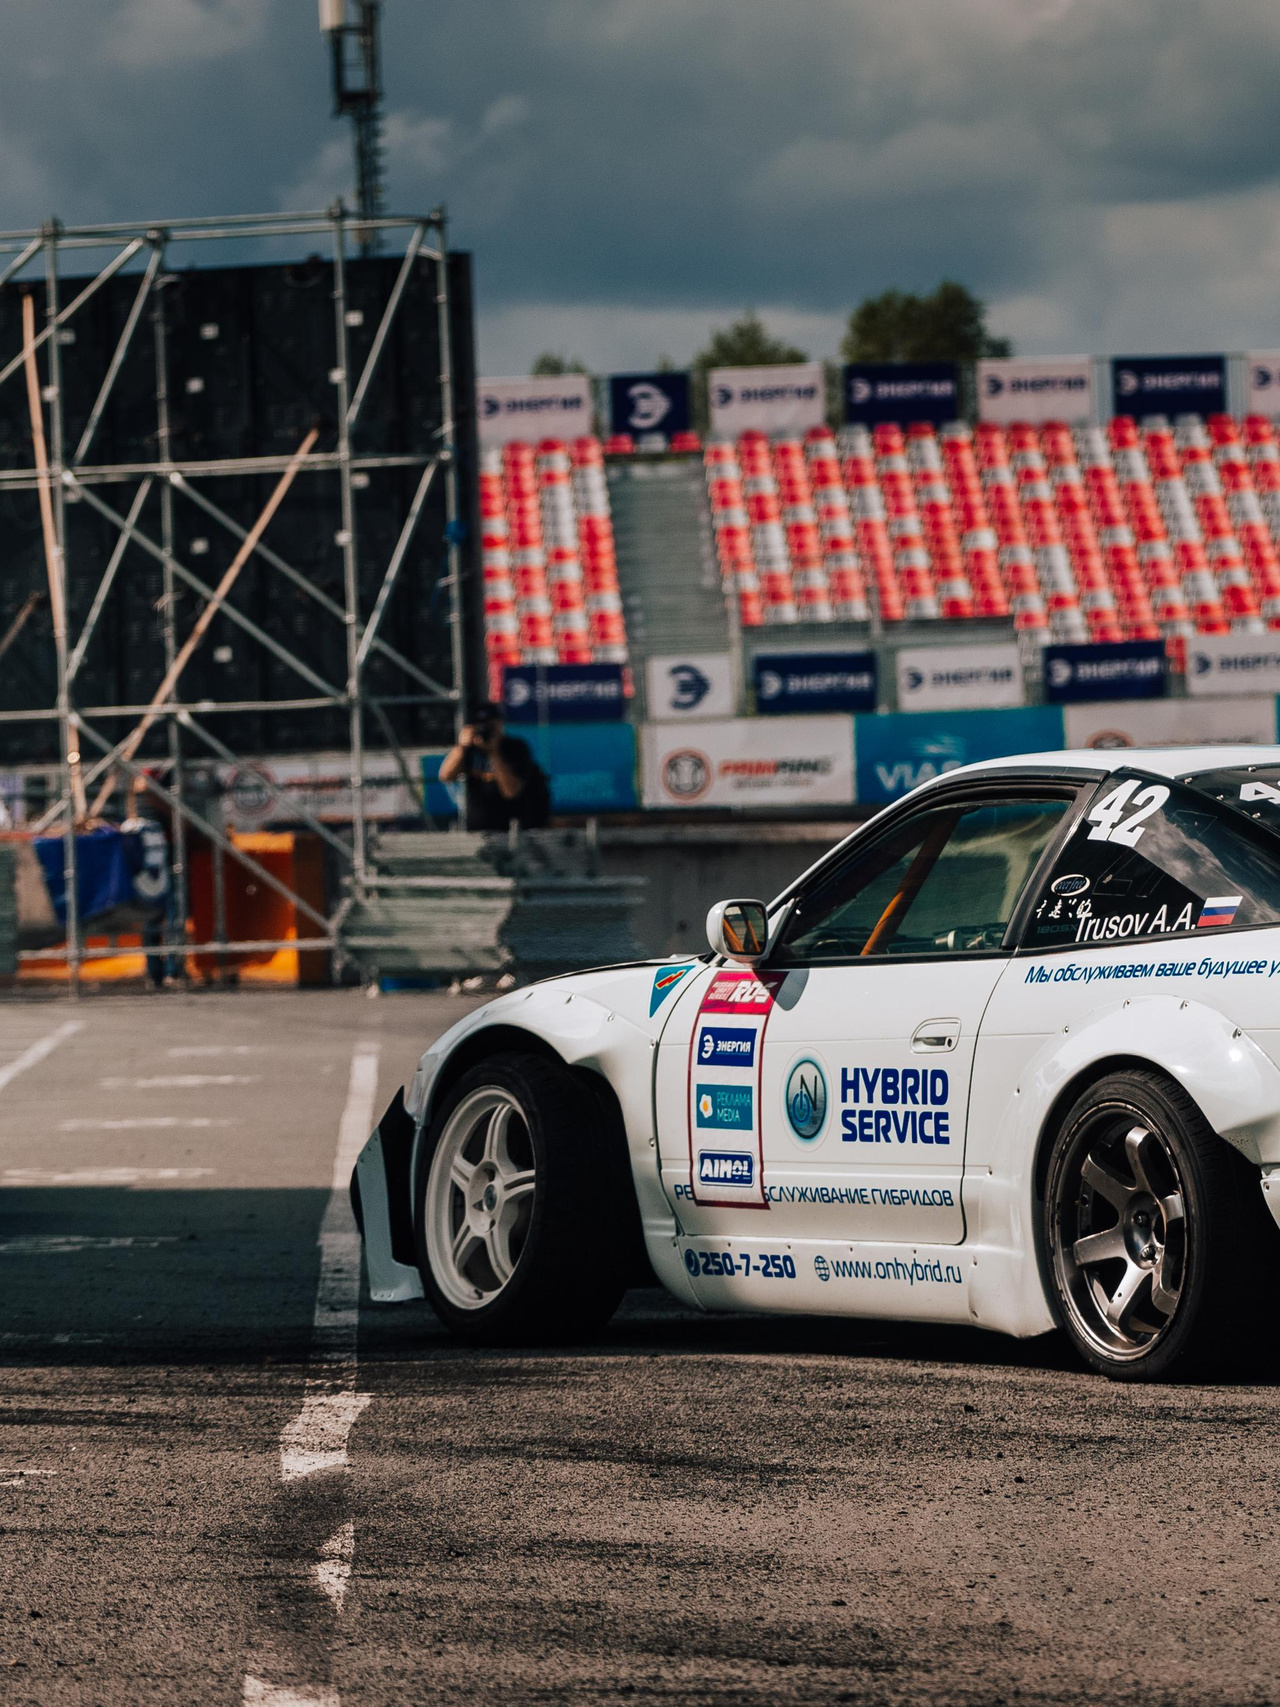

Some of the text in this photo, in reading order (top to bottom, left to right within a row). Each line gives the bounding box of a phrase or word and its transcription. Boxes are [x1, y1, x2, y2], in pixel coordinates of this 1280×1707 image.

[1087, 779, 1170, 847] 42
[1075, 902, 1196, 942] Trusov A.A.
[1024, 965, 1051, 984] Мы
[1054, 964, 1154, 985] обслуживаем
[1154, 961, 1197, 977] ваше
[1197, 957, 1267, 979] будущее
[716, 1040, 751, 1053] ЭНЕРГИЯ
[841, 1067, 949, 1105] HYBRID
[717, 1108, 740, 1122] MEDIA
[840, 1109, 950, 1144] SERVICE
[701, 1158, 751, 1178] AIMOL
[871, 1188, 954, 1206] ГИБРИДОВ
[699, 1252, 796, 1279] 250-7-250
[831, 1257, 962, 1285] www.onhybrid.ru
